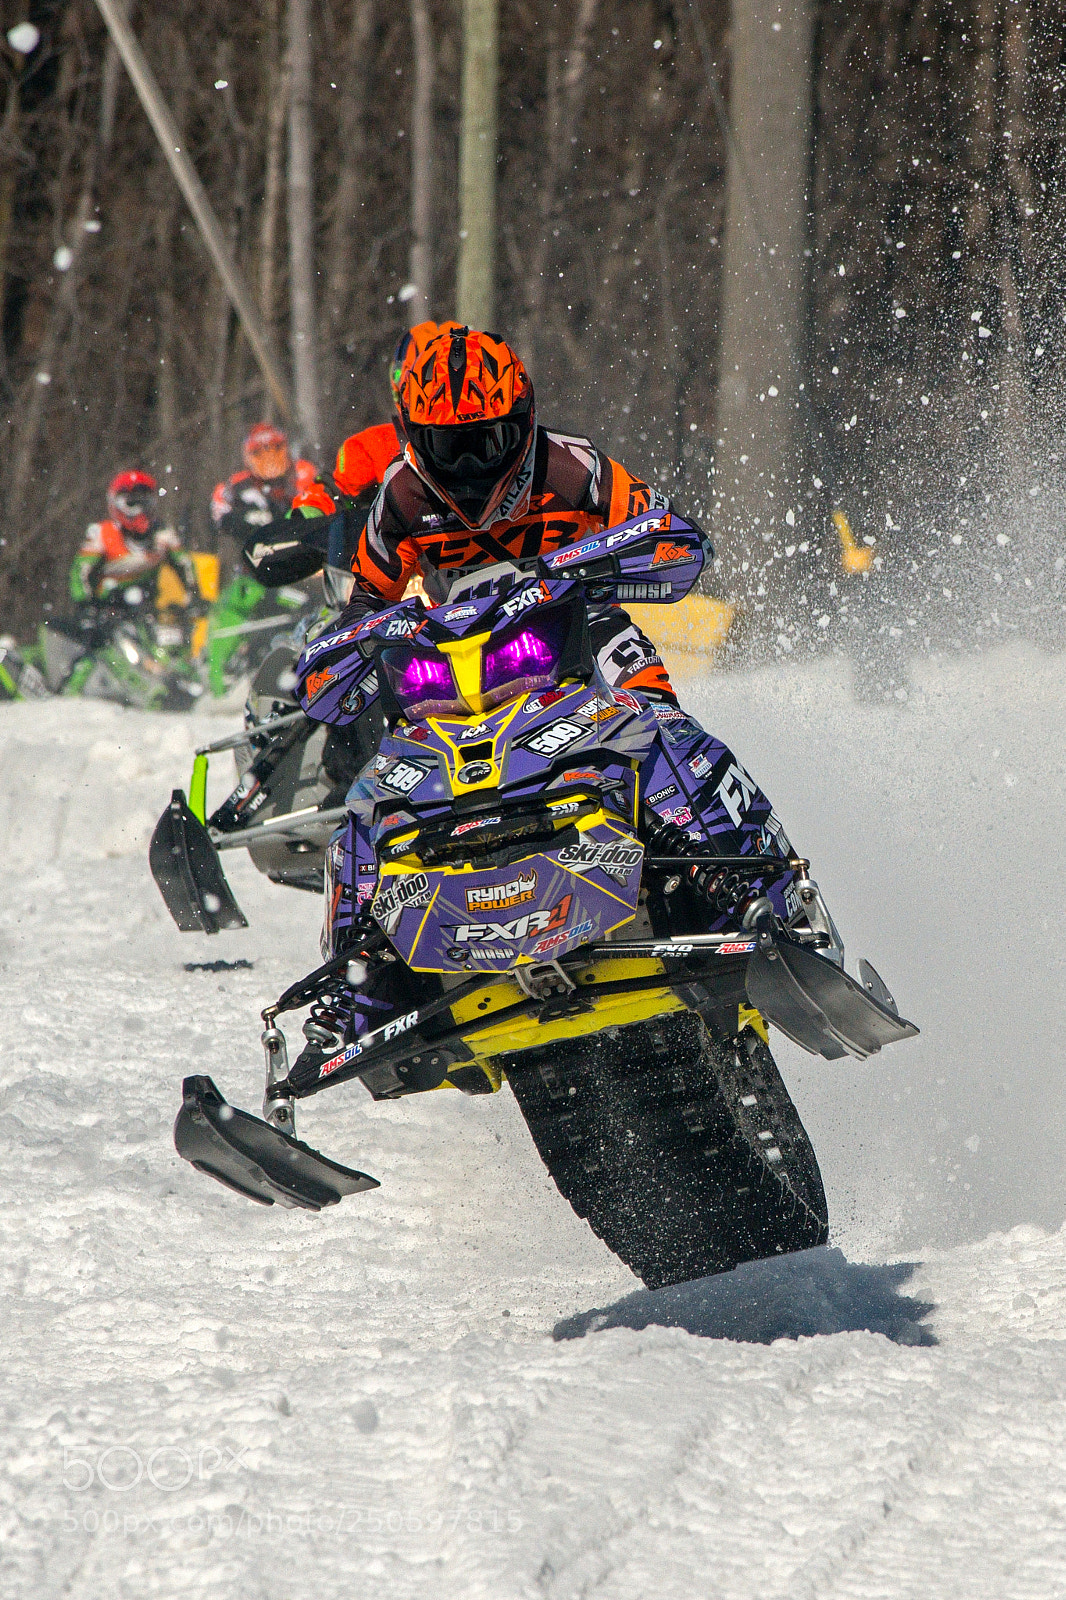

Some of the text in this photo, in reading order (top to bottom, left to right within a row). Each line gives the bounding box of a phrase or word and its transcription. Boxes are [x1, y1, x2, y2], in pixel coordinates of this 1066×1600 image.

[499, 469, 532, 517] ATLAS
[551, 541, 600, 567] AMSOIL
[617, 582, 673, 600] WASP
[527, 723, 582, 753] 509
[385, 763, 424, 791] 509
[649, 785, 676, 803] BIONIC
[450, 816, 501, 836] AMSOIL
[608, 867, 633, 875] TEAM
[468, 890, 535, 911] POWER
[530, 919, 593, 955] AMSOIL
[470, 948, 515, 960] WASP
[384, 1010, 419, 1041] FXR
[318, 1044, 363, 1078] AMSOIL
